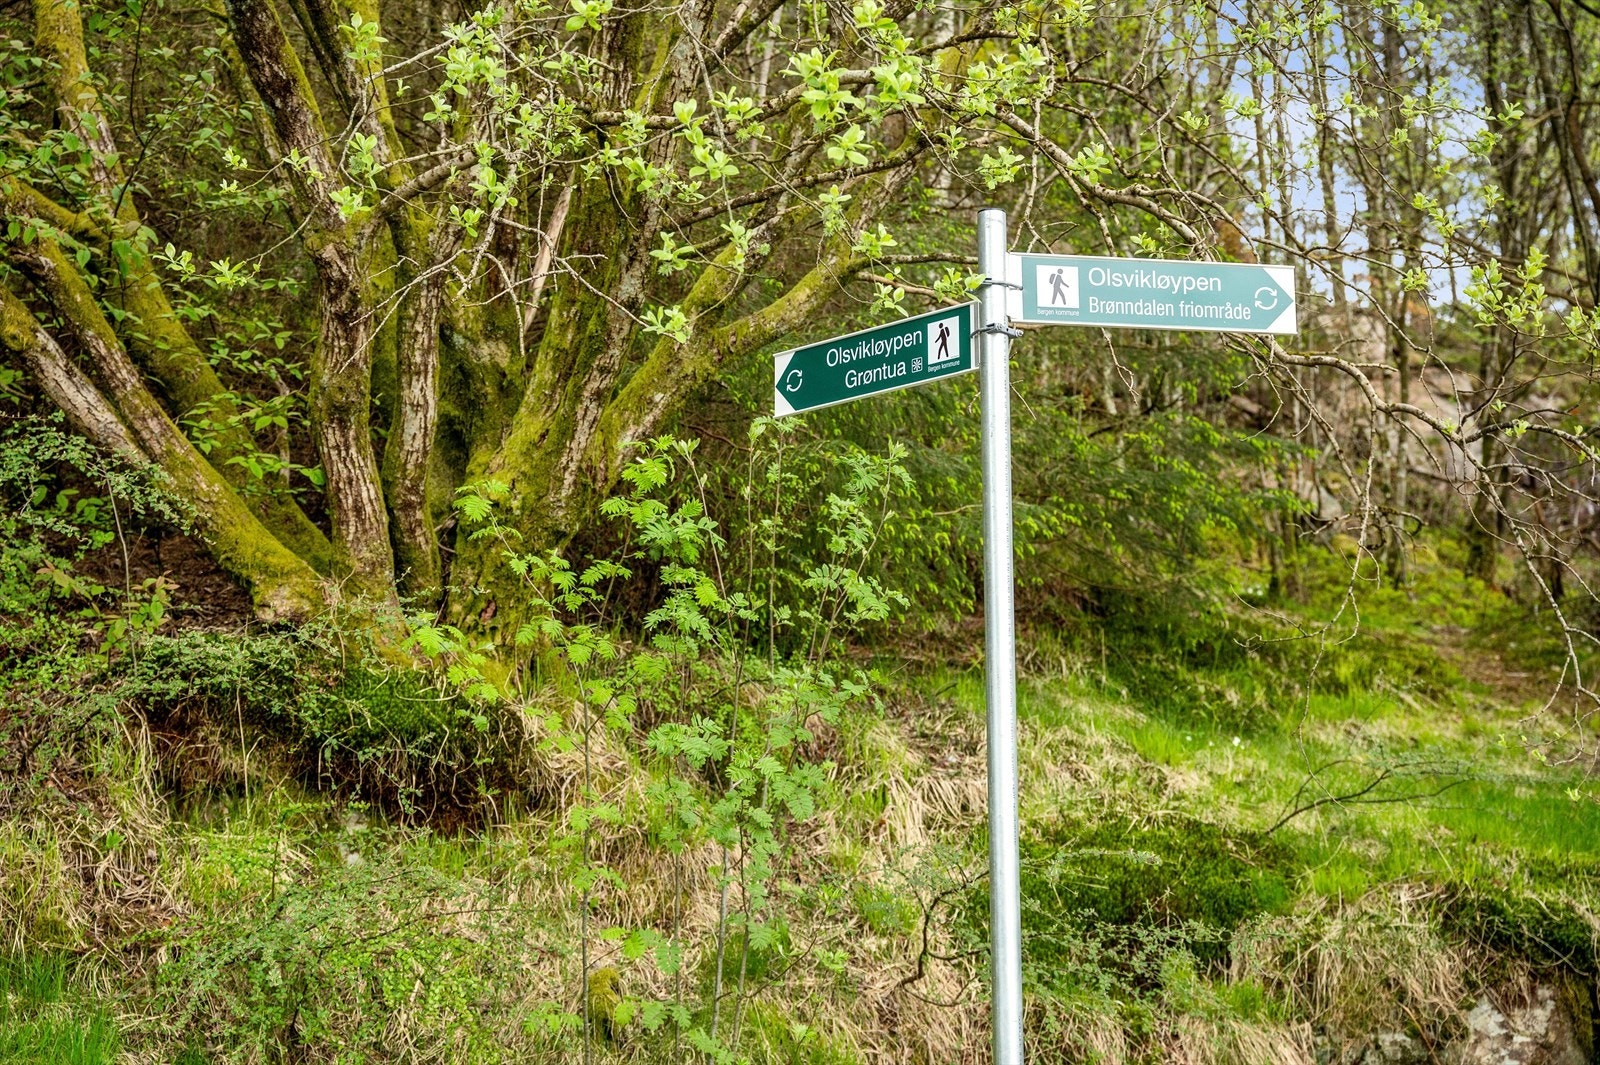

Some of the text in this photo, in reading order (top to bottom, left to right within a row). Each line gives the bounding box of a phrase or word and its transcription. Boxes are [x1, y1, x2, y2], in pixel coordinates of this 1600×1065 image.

[1088, 267, 1222, 294] Olsvikløypen
[1055, 309, 1080, 317] kommune
[1089, 296, 1251, 320] Brønndalen friområde
[826, 330, 922, 367] Olsvikløypen
[845, 361, 907, 388] Grøntua
[941, 360, 961, 370] kommune
